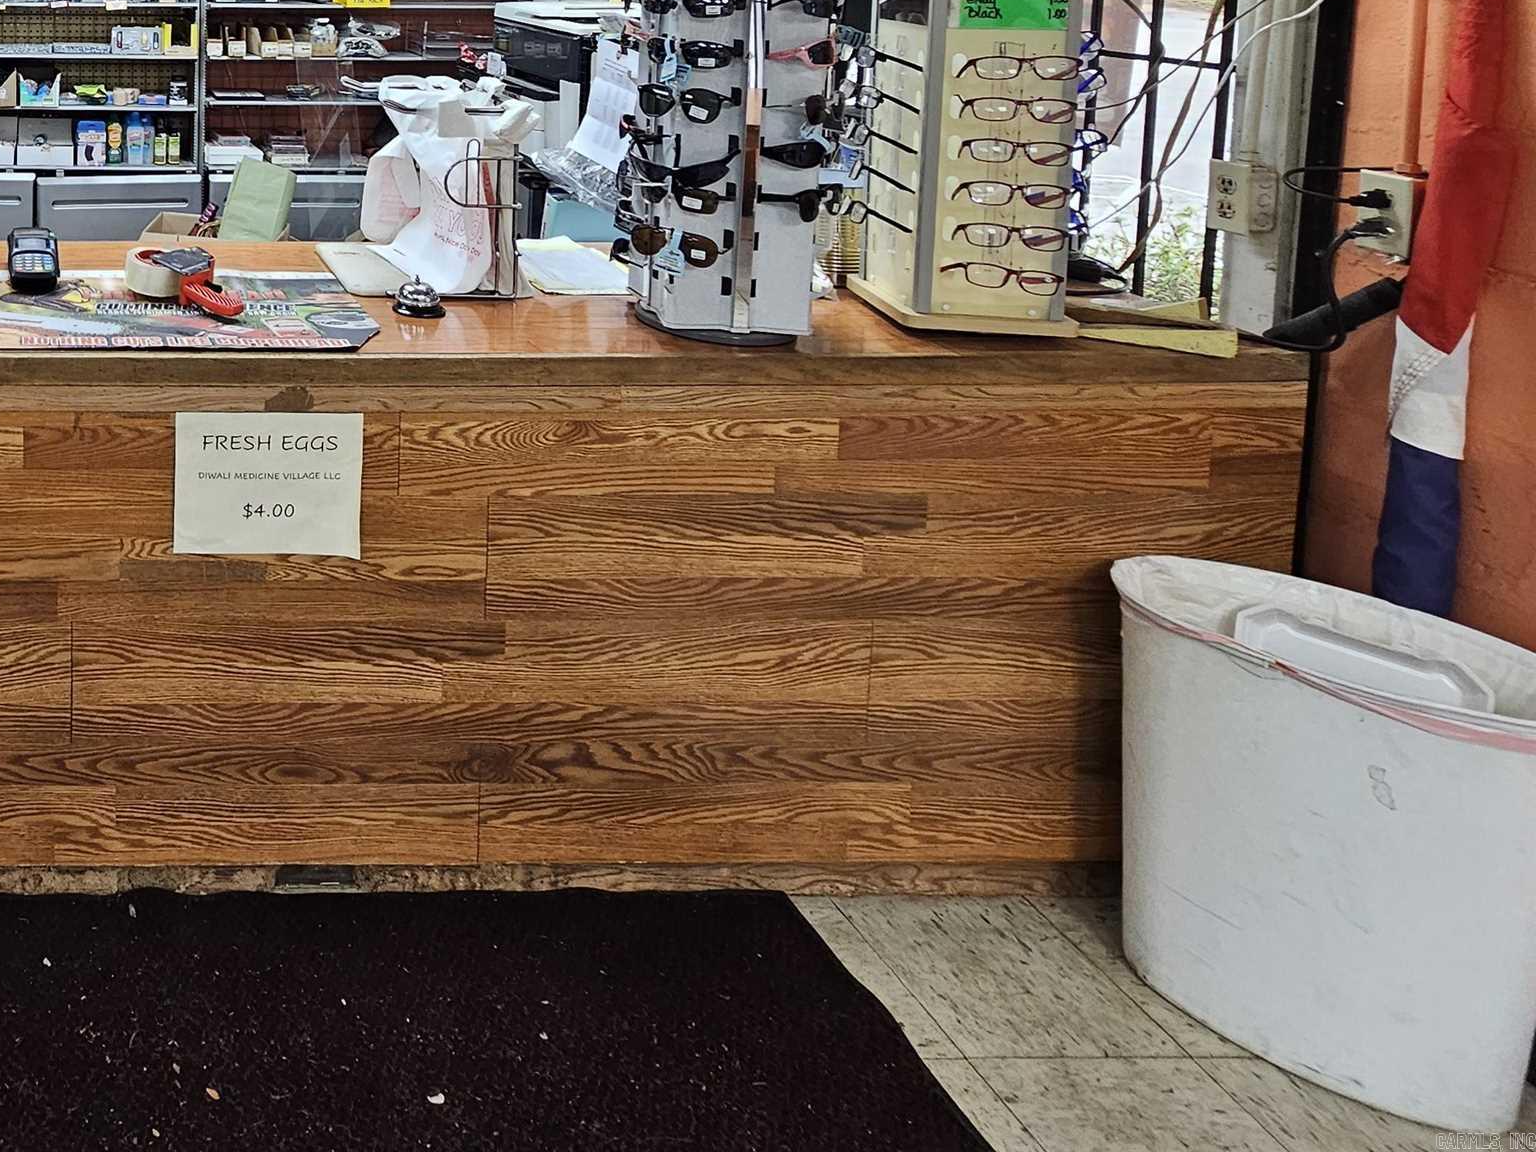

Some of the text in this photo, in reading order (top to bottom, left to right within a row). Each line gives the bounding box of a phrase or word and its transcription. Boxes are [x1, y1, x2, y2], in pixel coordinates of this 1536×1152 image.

[964, 6, 1002, 20] Black
[21, 335, 108, 348] NOTHING
[111, 335, 163, 348] CUTS
[166, 335, 207, 348] LIKE
[202, 435, 338, 452] FRESH EGGS
[198, 472, 341, 480] DIWALI MEDICINE VILLAGE LLC
[242, 503, 295, 519] $4.00
